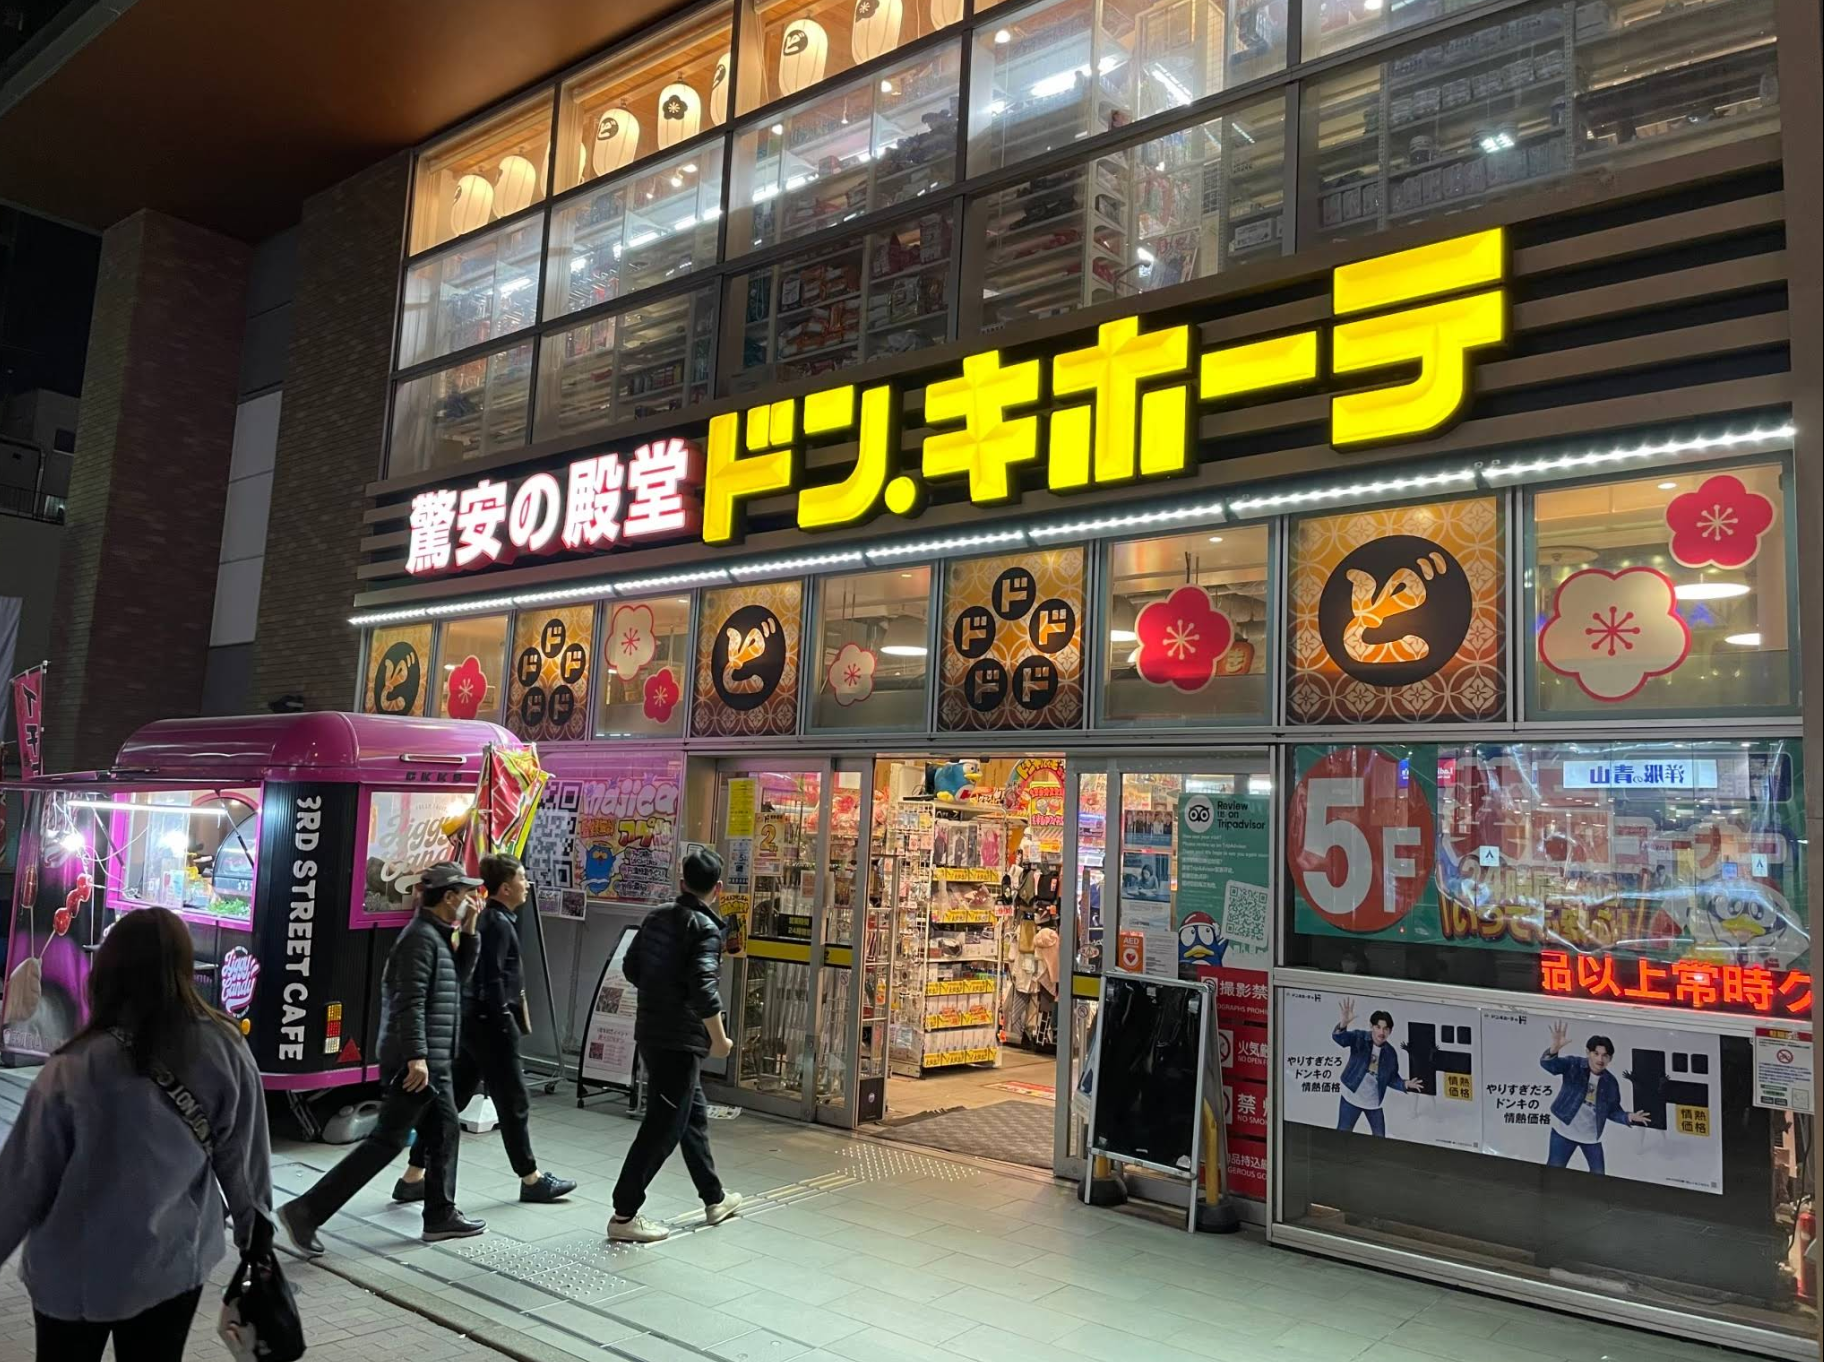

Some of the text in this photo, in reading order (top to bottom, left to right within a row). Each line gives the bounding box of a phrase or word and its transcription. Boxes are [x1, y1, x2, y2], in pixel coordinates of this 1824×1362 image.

[406, 438, 694, 574] 驚安の殿堂
[584, 778, 679, 818] majica
[1217, 801, 1249, 811] Review
[1217, 819, 1266, 831] Tripadvisor
[278, 795, 322, 1061] 3RD STREET CAFE
[1123, 937, 1139, 945] AED
[1247, 1057, 1262, 1065] OPEN
[1287, 1055, 1343, 1067] やりすぎだろ
[1295, 1068, 1332, 1080] ドンキの
[1301, 1081, 1341, 1093] 情熱価格
[1448, 1075, 1470, 1087] 情熱
[1448, 1087, 1470, 1098] 価格
[1486, 1084, 1553, 1097] やりすぎだろ
[1496, 1098, 1540, 1110] ドンキの
[1237, 1114, 1248, 1122] NO
[1503, 1112, 1551, 1125] 情熱価格
[1681, 1108, 1706, 1121] 情熱
[1681, 1121, 1706, 1134] 価格
